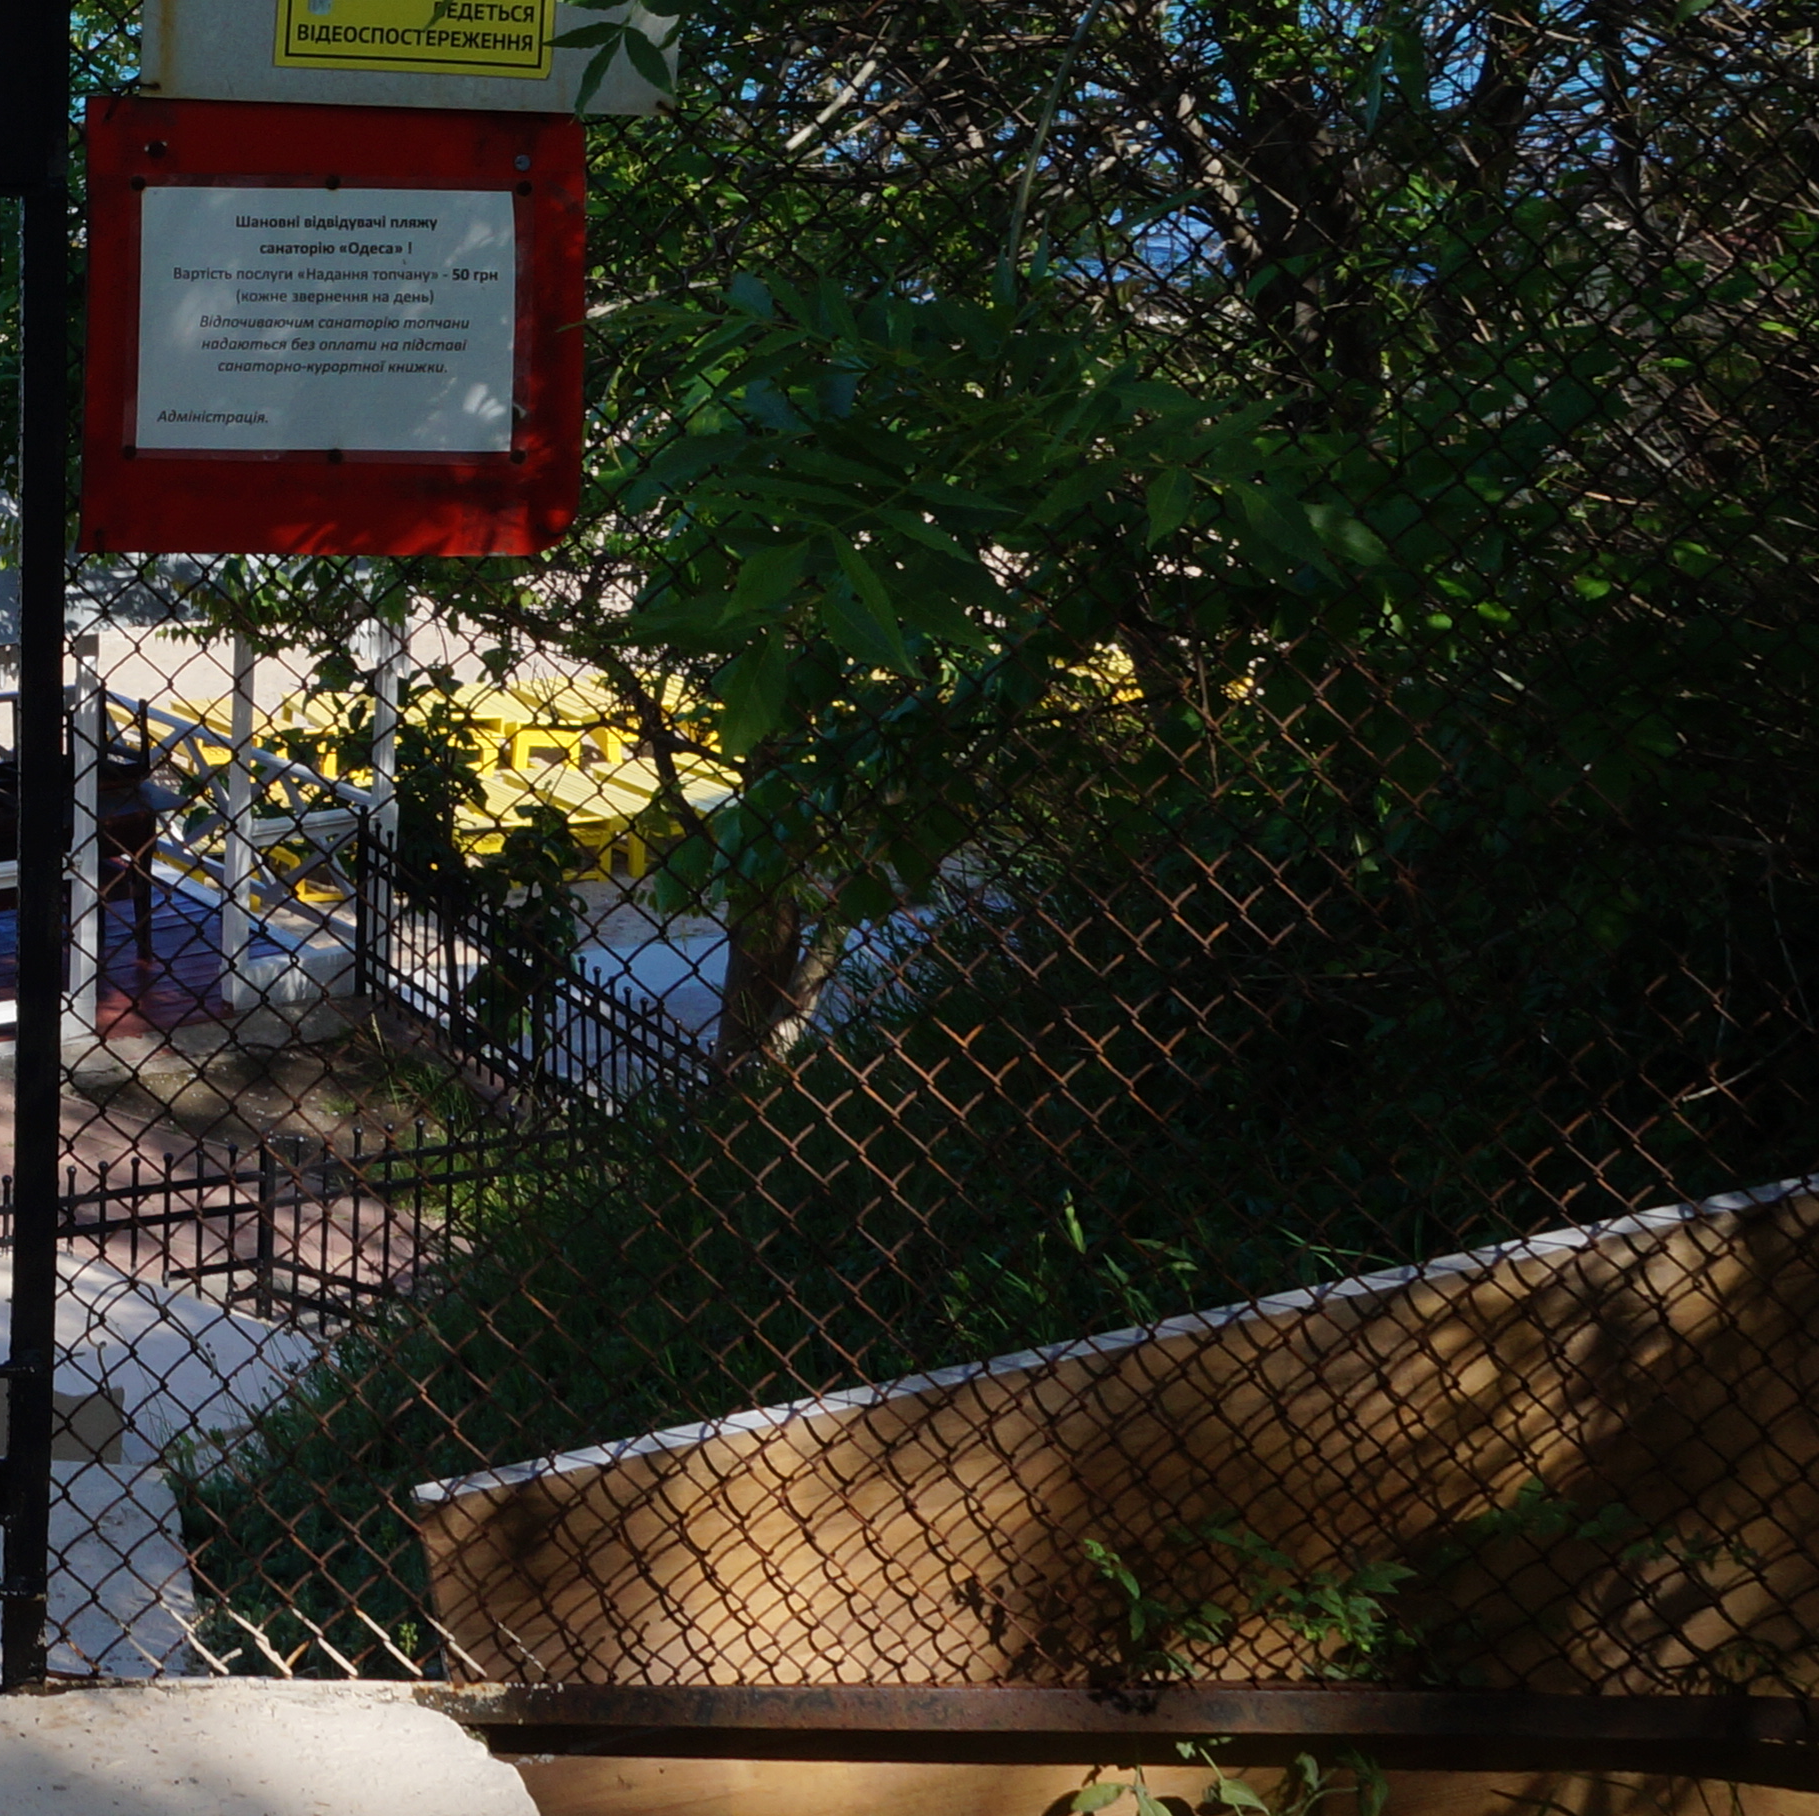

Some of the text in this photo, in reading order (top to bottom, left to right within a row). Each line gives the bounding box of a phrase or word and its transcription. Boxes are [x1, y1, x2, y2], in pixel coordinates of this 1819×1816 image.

[297, 24, 533, 52] ВІДЕОСПОСТЕРЕЖЕННЯ
[236, 215, 438, 231] Шановні відвідувачі пляжу
[259, 241, 335, 256] санаторію
[339, 242, 403, 256] «Одеса»
[173, 267, 232, 282] Вартість
[236, 270, 293, 284] послуги
[298, 268, 368, 283] «Надання
[372, 270, 438, 283] топчану»
[451, 268, 470, 282] 50
[473, 270, 499, 285] грн
[236, 290, 434, 305] (кожне звернення на день)
[199, 315, 470, 332] Відпочиваючим санаторію топчани
[201, 337, 467, 353] надаються без оплати на підставі
[217, 360, 448, 376] санаторно-курортної книжки.
[157, 409, 269, 425] Адміністрація.
